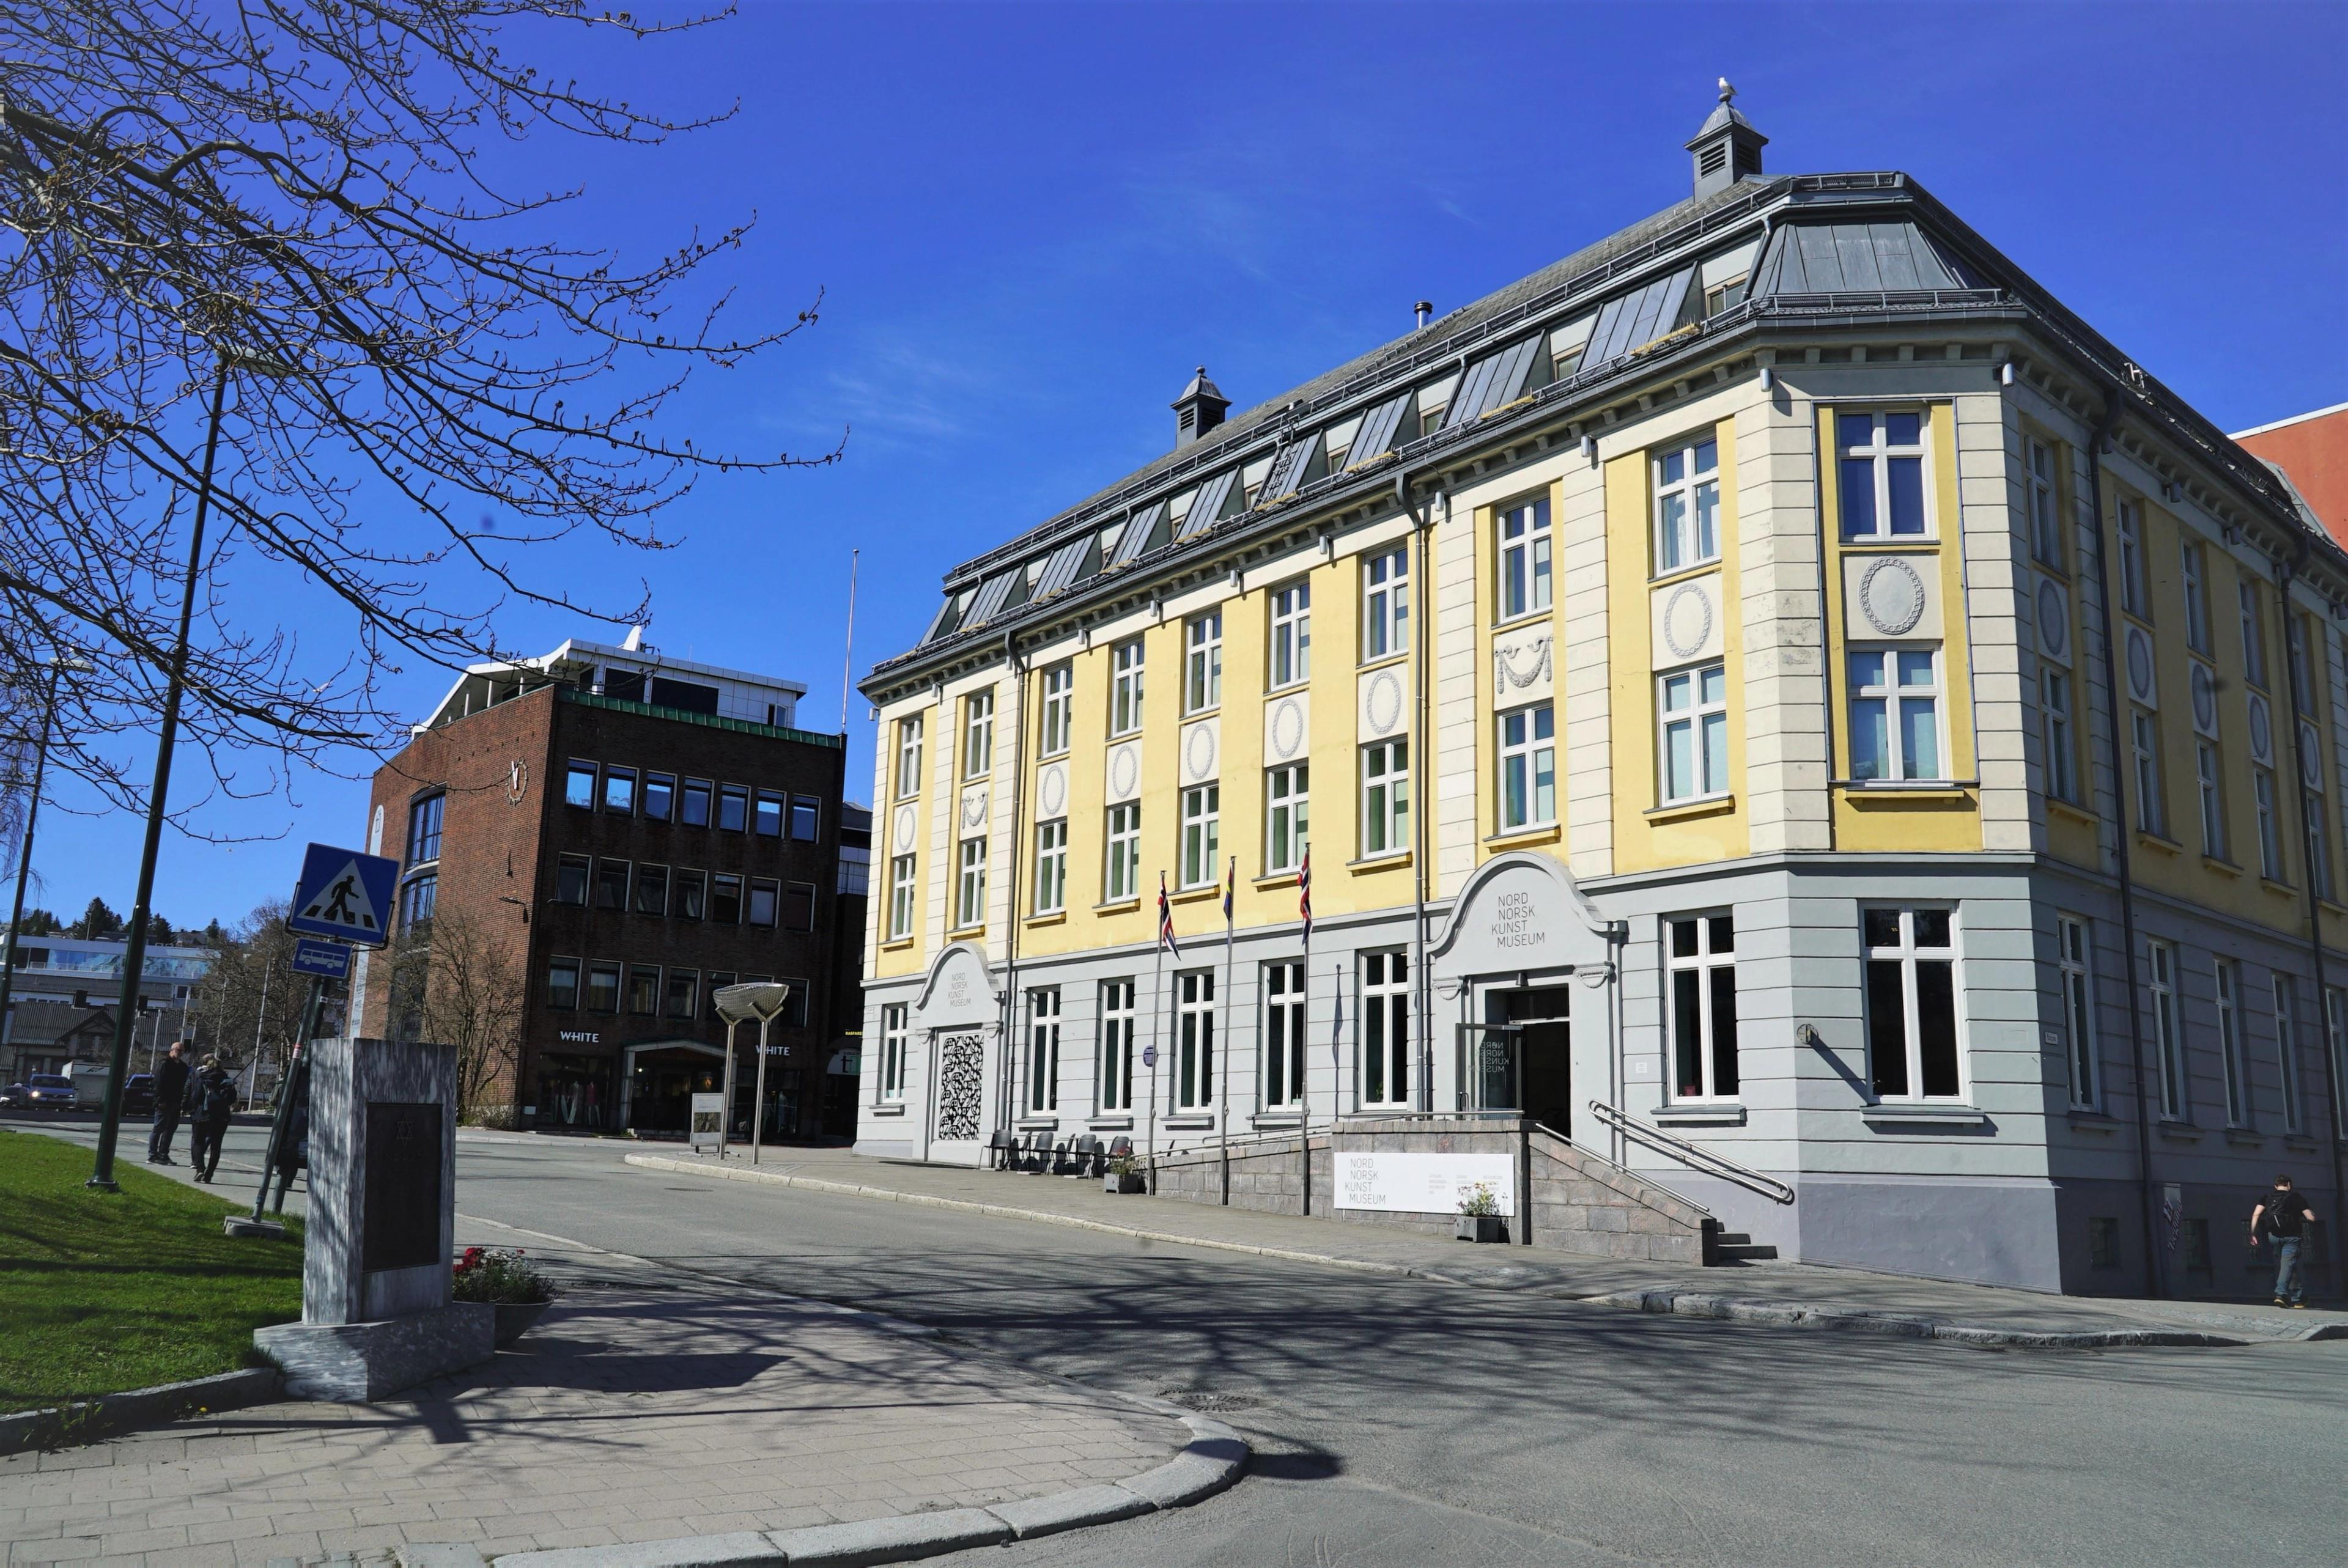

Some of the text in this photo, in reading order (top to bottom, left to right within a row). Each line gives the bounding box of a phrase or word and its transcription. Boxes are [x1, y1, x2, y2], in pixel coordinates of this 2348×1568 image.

[1498, 893, 1528, 907] NORD
[1498, 905, 1535, 920] NORSK
[1491, 920, 1527, 935] KUNST
[1497, 932, 1545, 948] MUSEUM
[951, 981, 968, 990] NORSK
[948, 990, 964, 999] KUNST
[950, 998, 972, 1007] MUSEUM
[559, 1031, 599, 1043] WHITE
[1350, 1158, 1373, 1169] NORD
[1350, 1170, 1379, 1180] NORSK
[1345, 1182, 1372, 1192] KUNST
[1349, 1194, 1386, 1205] MUSEUM
